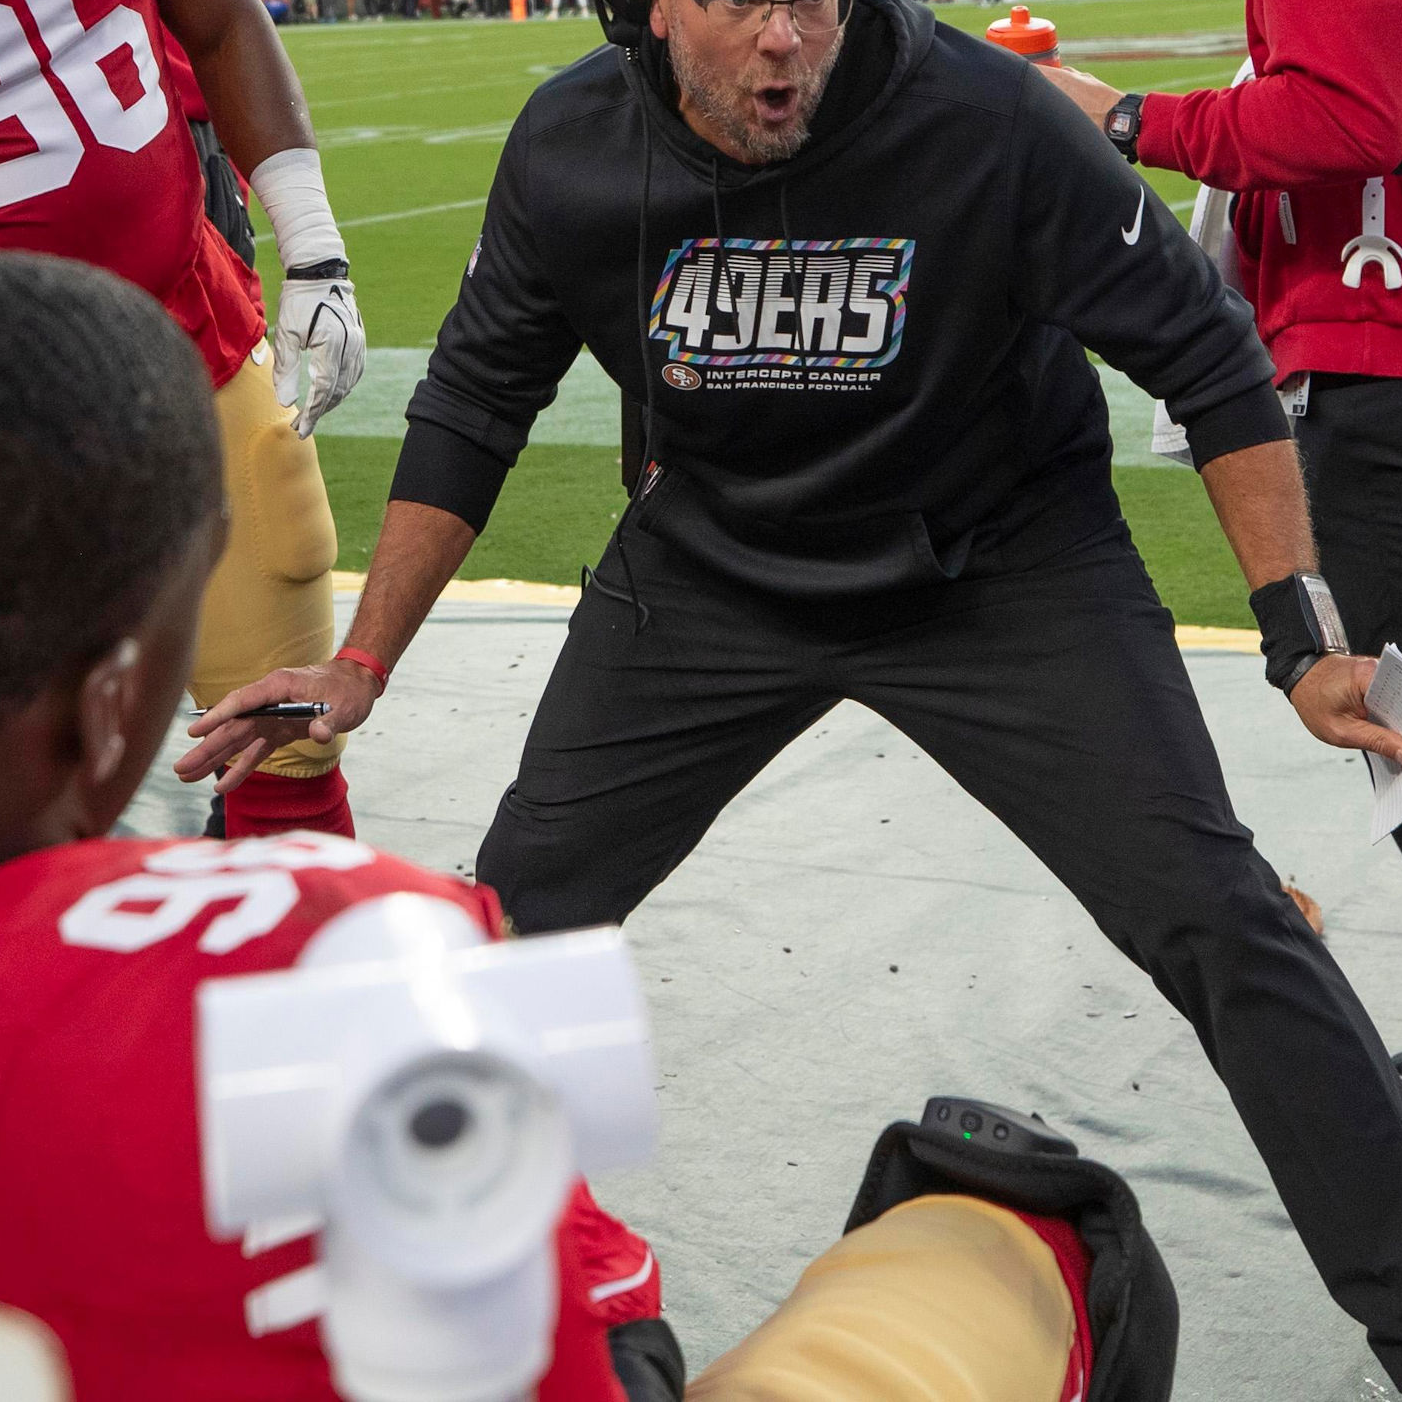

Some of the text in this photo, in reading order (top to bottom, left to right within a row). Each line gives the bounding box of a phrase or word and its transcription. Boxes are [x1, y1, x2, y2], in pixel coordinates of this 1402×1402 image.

[665, 253, 896, 353] 49ERS
[706, 369, 882, 382] INTERCEPT CANCER
[706, 382, 872, 391] SAN FRANCISCO FOOTBALL
